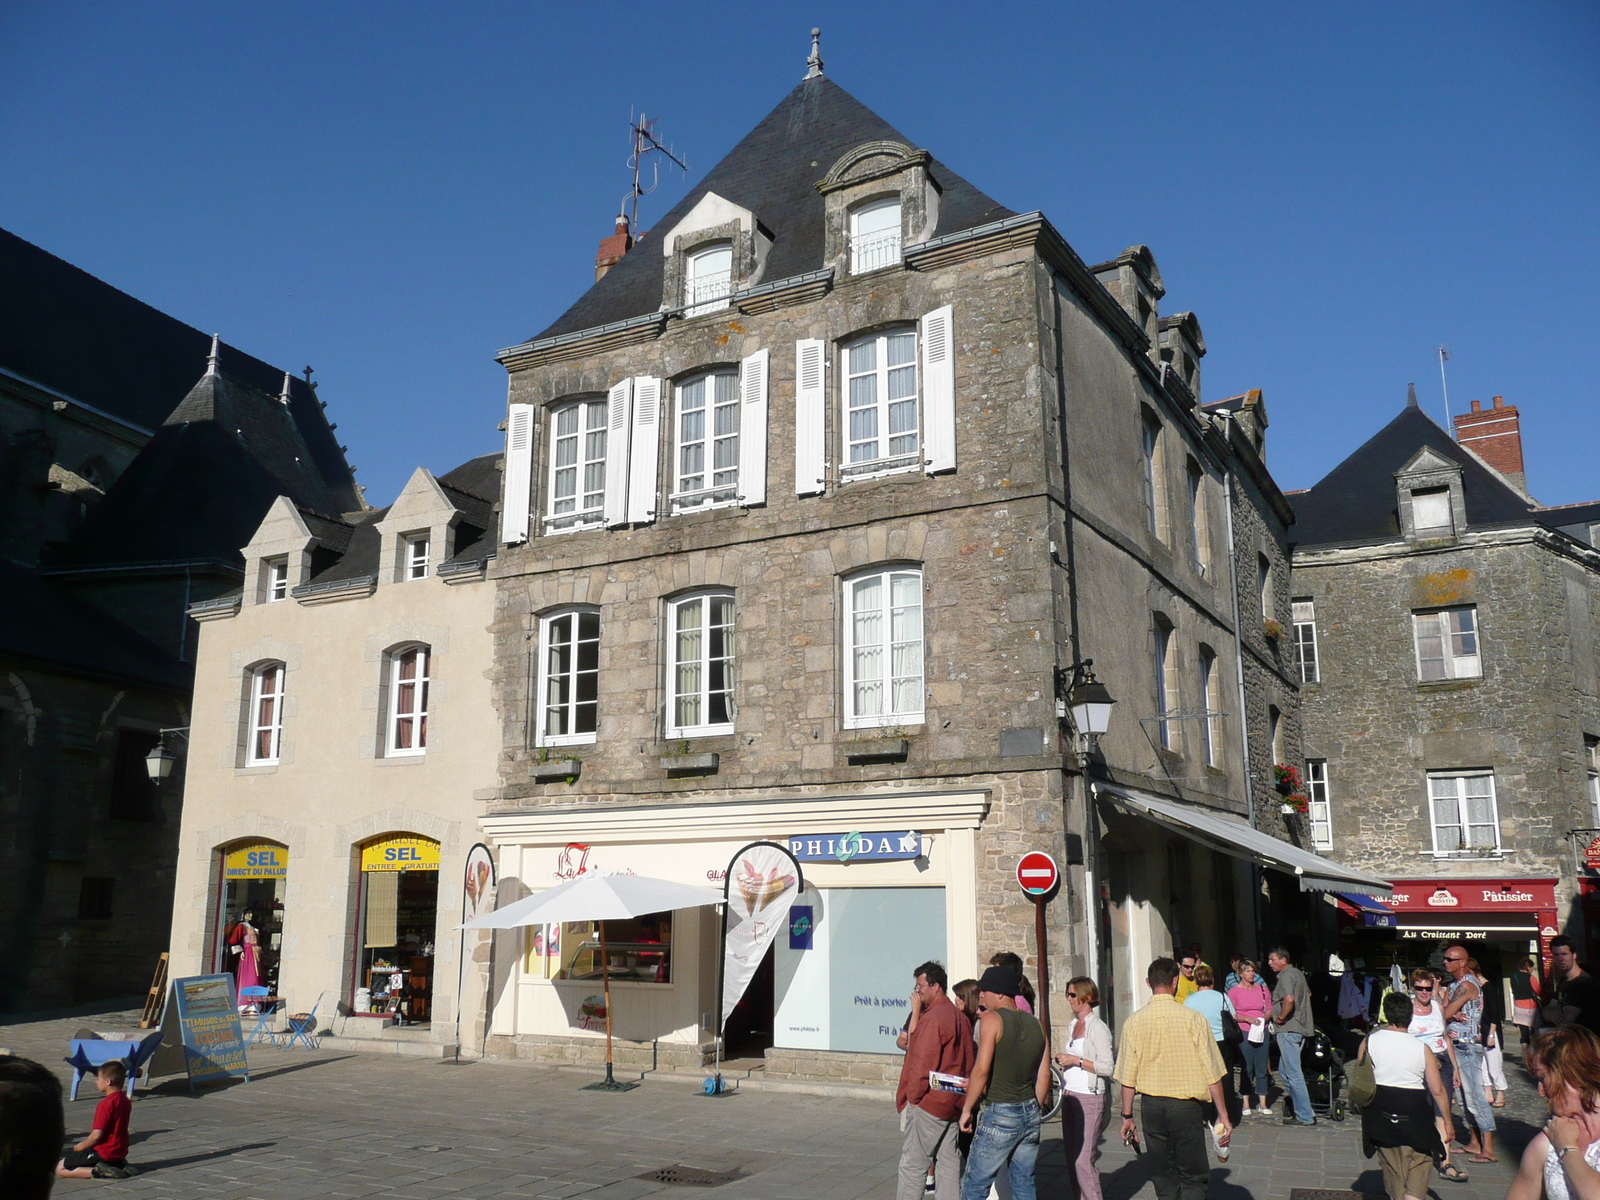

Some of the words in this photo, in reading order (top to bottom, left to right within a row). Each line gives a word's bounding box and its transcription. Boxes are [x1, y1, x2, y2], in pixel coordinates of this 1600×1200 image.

[246, 851, 280, 866] SEL
[384, 847, 422, 861] SEL
[227, 868, 251, 876] DIRECT
[252, 868, 262, 876] DU
[1482, 890, 1533, 902] Pâtissier
[1403, 930, 1417, 938] Au
[1421, 931, 1461, 939] Croissant
[1465, 931, 1487, 939] Doré
[854, 995, 872, 1006] Prêt
[874, 996, 880, 1006] à
[881, 997, 907, 1008] porter
[879, 1025, 890, 1036] Fil
[891, 1026, 898, 1036] à
